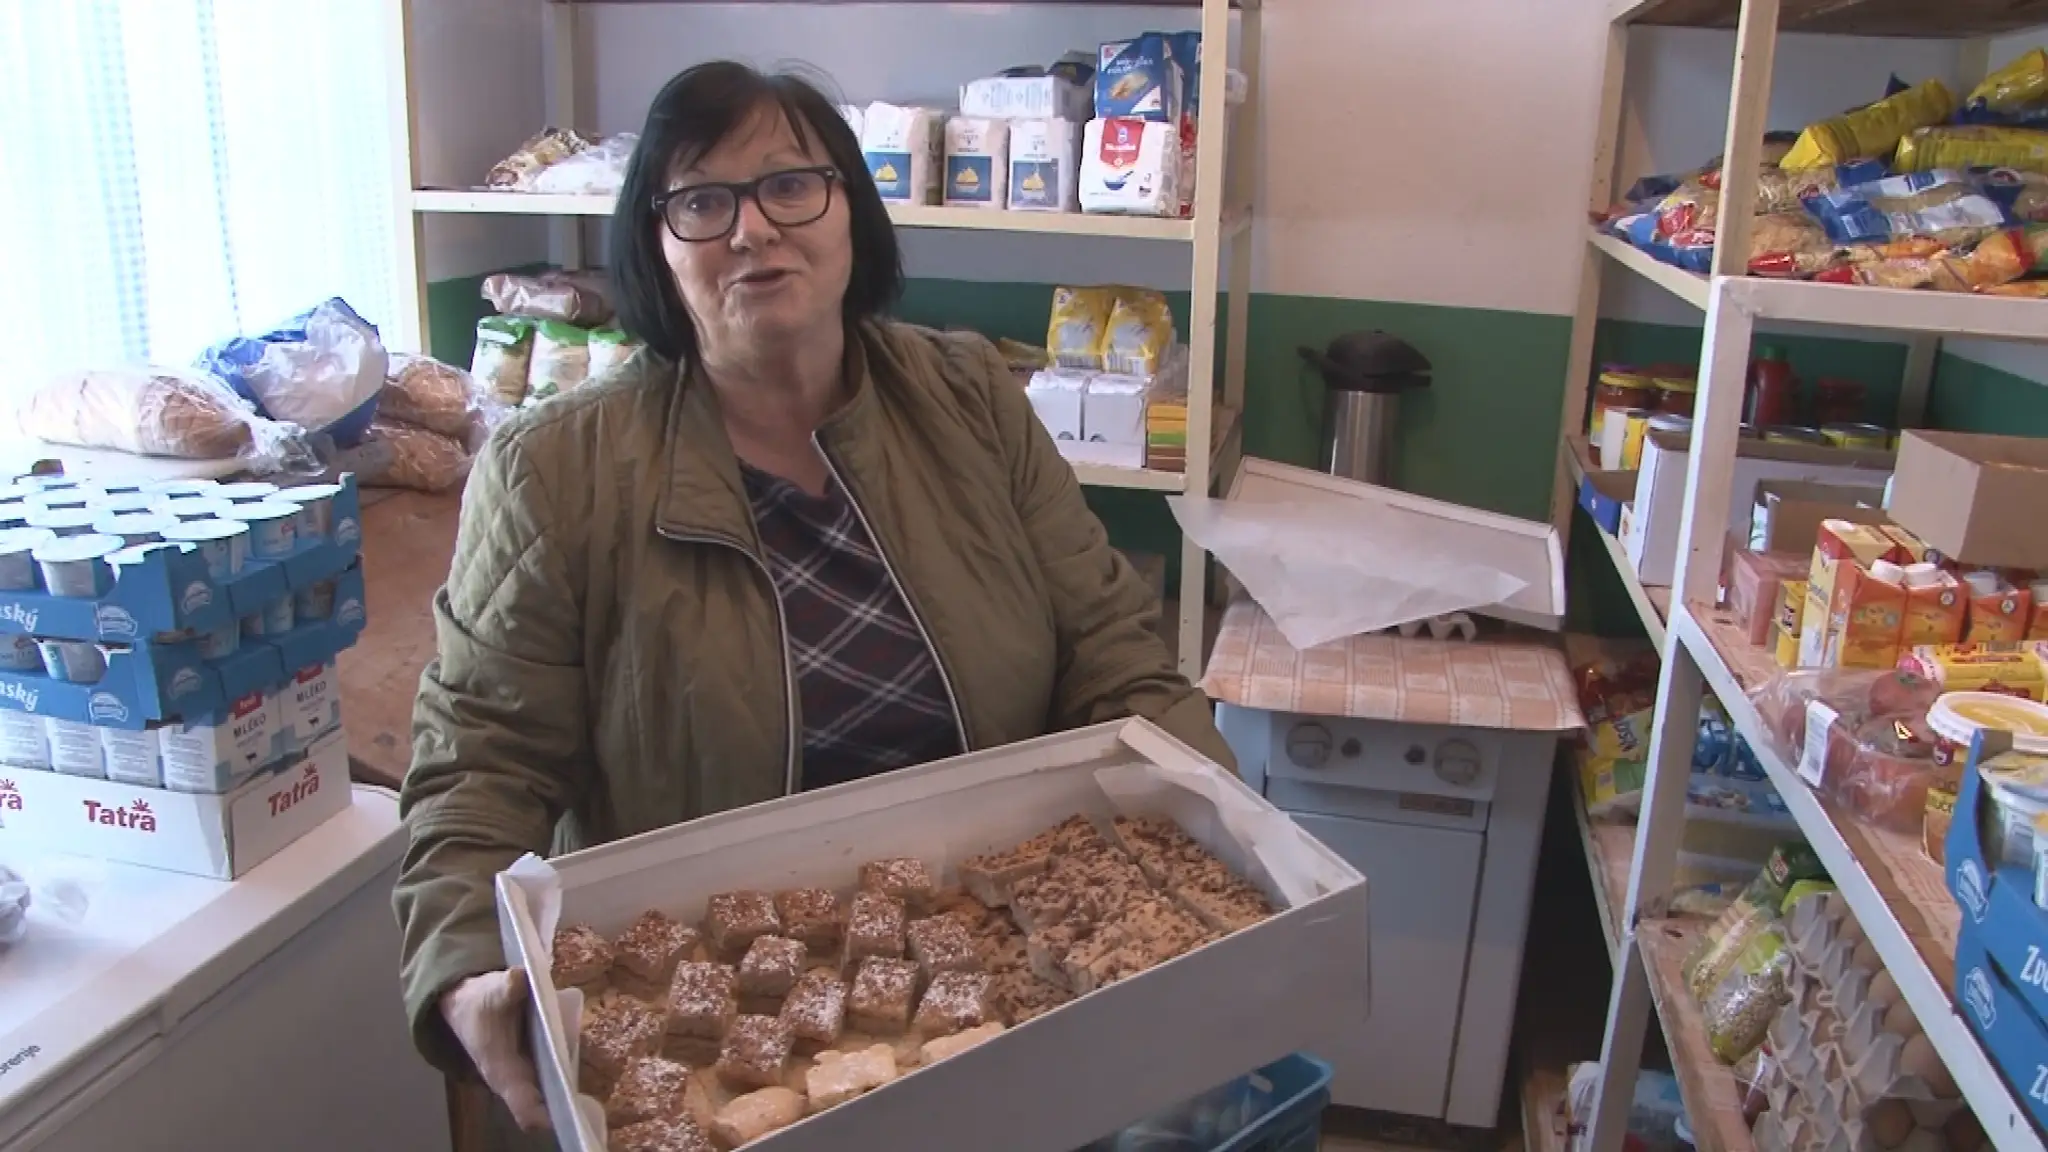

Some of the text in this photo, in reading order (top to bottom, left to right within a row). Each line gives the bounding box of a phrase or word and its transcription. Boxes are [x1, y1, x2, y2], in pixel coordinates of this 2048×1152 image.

[0, 603, 38, 632] ský
[233, 712, 267, 738] MLÉKO
[268, 774, 319, 818] Tatra
[83, 799, 156, 832] Tatra
